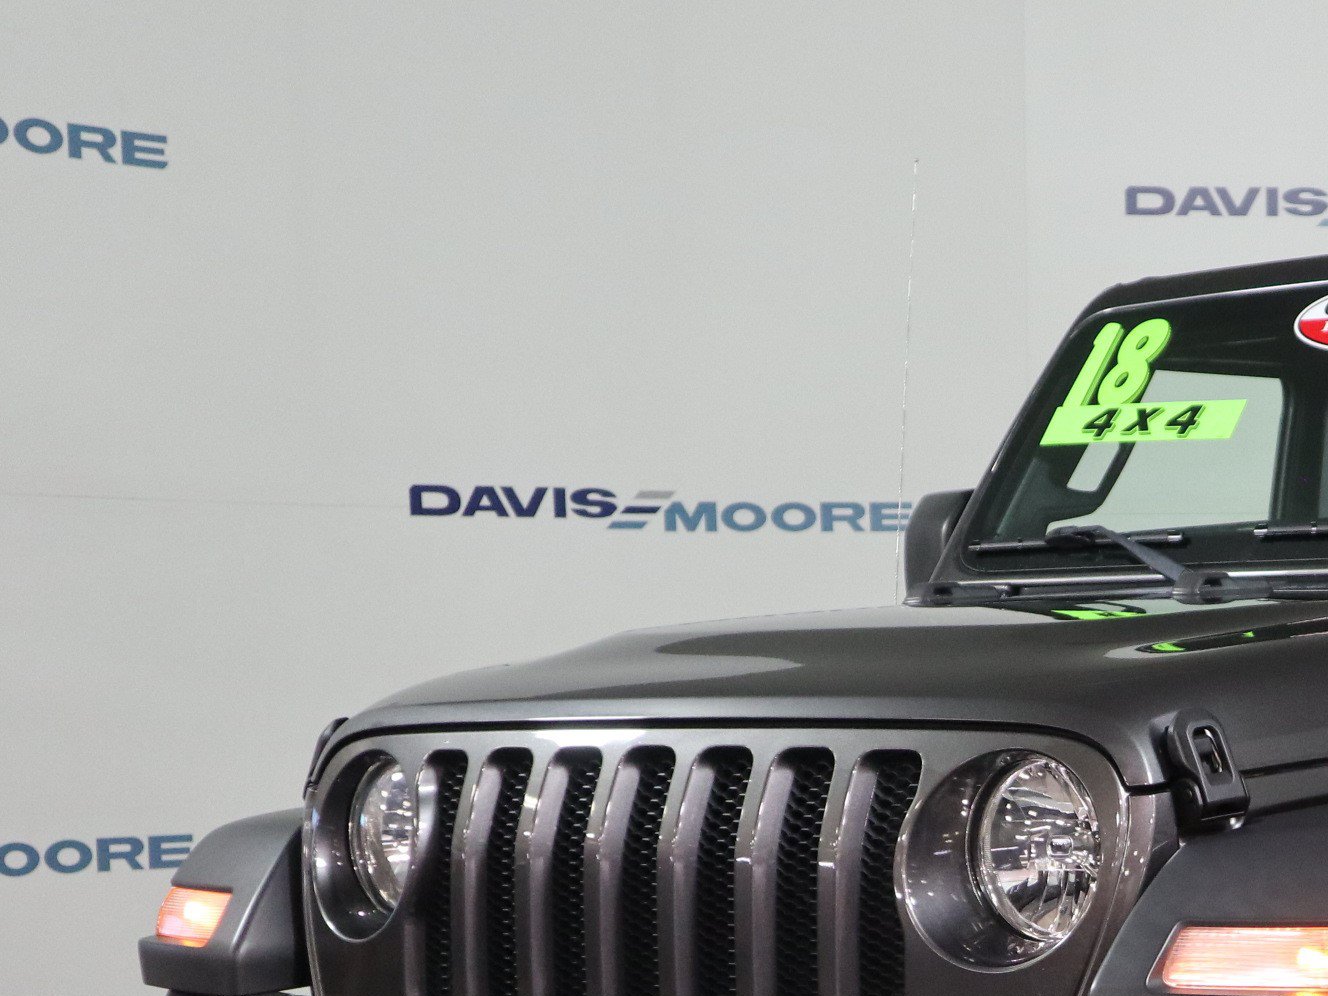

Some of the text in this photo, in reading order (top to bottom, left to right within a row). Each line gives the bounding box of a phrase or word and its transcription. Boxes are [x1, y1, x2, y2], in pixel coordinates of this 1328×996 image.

[0, 116, 168, 169] ORE
[1062, 318, 1172, 405] 18
[408, 484, 913, 534] DAVIS MOORE
